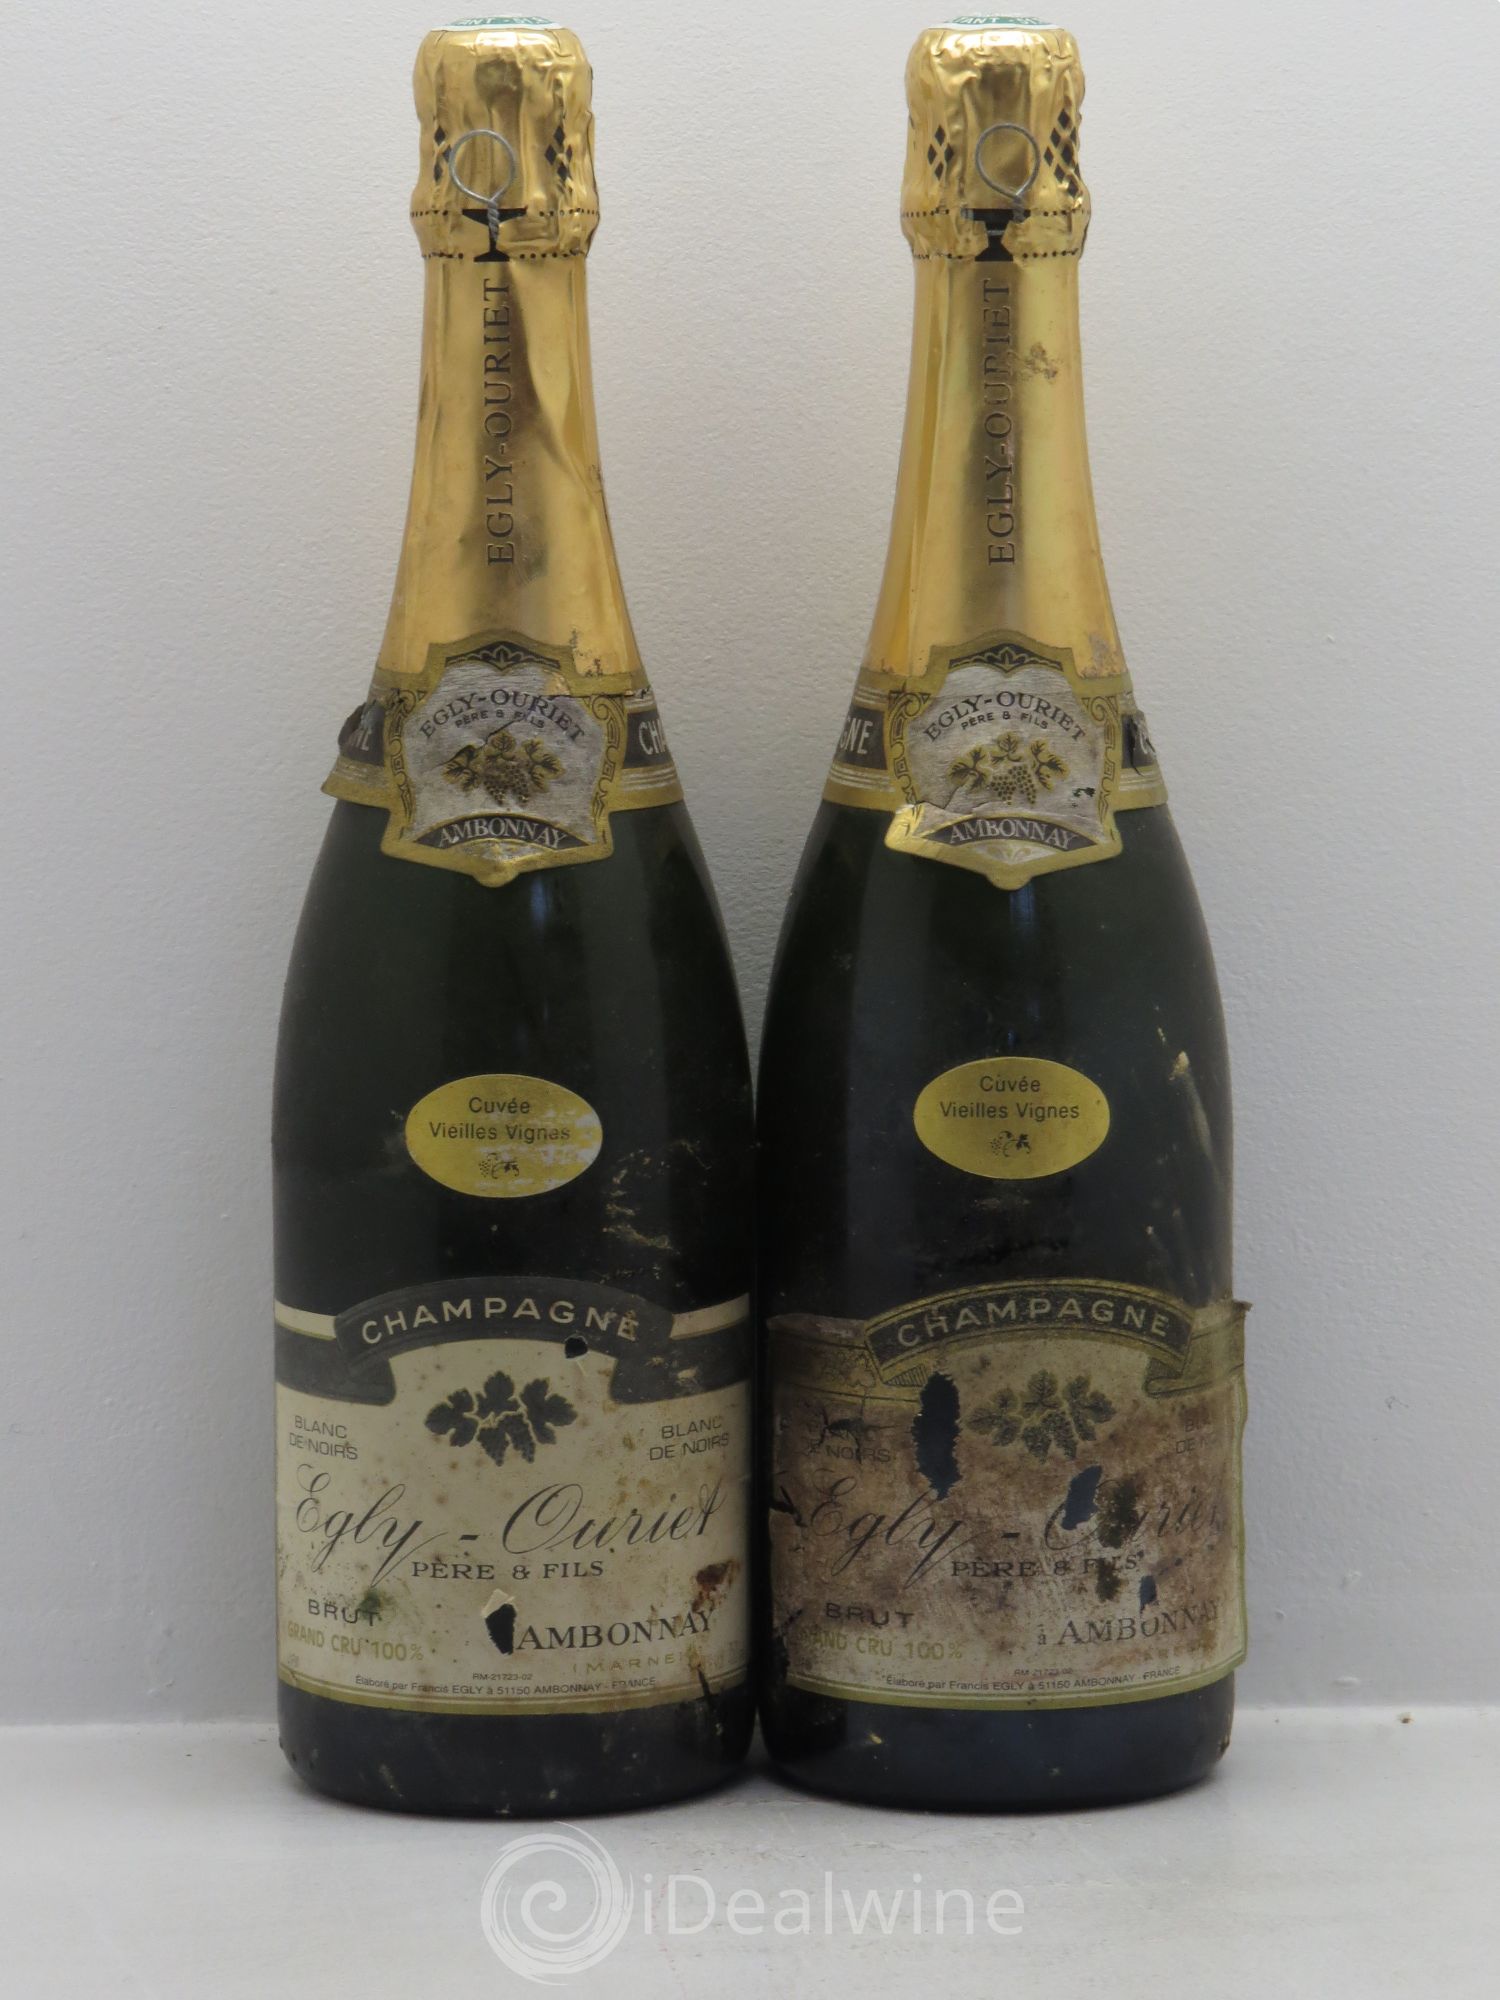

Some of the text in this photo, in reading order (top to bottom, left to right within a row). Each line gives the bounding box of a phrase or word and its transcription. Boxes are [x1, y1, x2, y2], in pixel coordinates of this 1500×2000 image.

[483, 278, 514, 566] EGLY-OURIET
[983, 279, 1015, 566] EGLY-OURIET
[419, 689, 586, 742] EGLY-OURIET
[513, 710, 545, 729] FILS
[923, 691, 1087, 743] EGLY-OURIET
[961, 712, 995, 731] PÈRE
[1020, 712, 1048, 730] FILS
[437, 816, 568, 850] AMBONNAY
[950, 818, 1079, 851] AMBONNAY
[979, 1075, 1041, 1093] Cuvée
[468, 1096, 531, 1114] Cuvée
[939, 1101, 1080, 1123] Vieilles Vignes
[429, 1121, 571, 1144] Vieilles Vignes
[361, 1297, 641, 1344] CHAMPAGNE
[897, 1297, 1171, 1347] CHAMPAGNE
[294, 1414, 348, 1440] BLANC
[661, 1415, 724, 1440] BLANC
[289, 1433, 359, 1461] DE NOIRS
[649, 1432, 730, 1462] DE NOIRS
[825, 1444, 892, 1463] NORS
[296, 1463, 449, 1588] Egly
[502, 1475, 727, 1554] Ouriet
[810, 1466, 994, 1590] Egly
[411, 1557, 604, 1580] PÈRE & FILS
[308, 1598, 381, 1627] BRUT
[825, 1602, 914, 1627] BRUT
[287, 1620, 424, 1662] GRAND CRU 100%
[515, 1608, 714, 1651] AMBONNAY
[856, 1636, 893, 1657] CRU
[904, 1641, 963, 1661] 100%
[392, 1682, 408, 1691] par
[411, 1682, 449, 1694] Francis
[452, 1684, 483, 1695] EGLY
[497, 1686, 531, 1695] 51150
[534, 1684, 602, 1695] AMBONNAY
[612, 1677, 656, 1689] FRANCE
[928, 1680, 946, 1690] par
[949, 1680, 990, 1691] Francis
[993, 1680, 1024, 1691] EGLY
[1038, 1679, 1071, 1690] 51150
[1074, 1675, 1135, 1689] AMBONNAY
[1143, 1666, 1181, 1680] FRANCE
